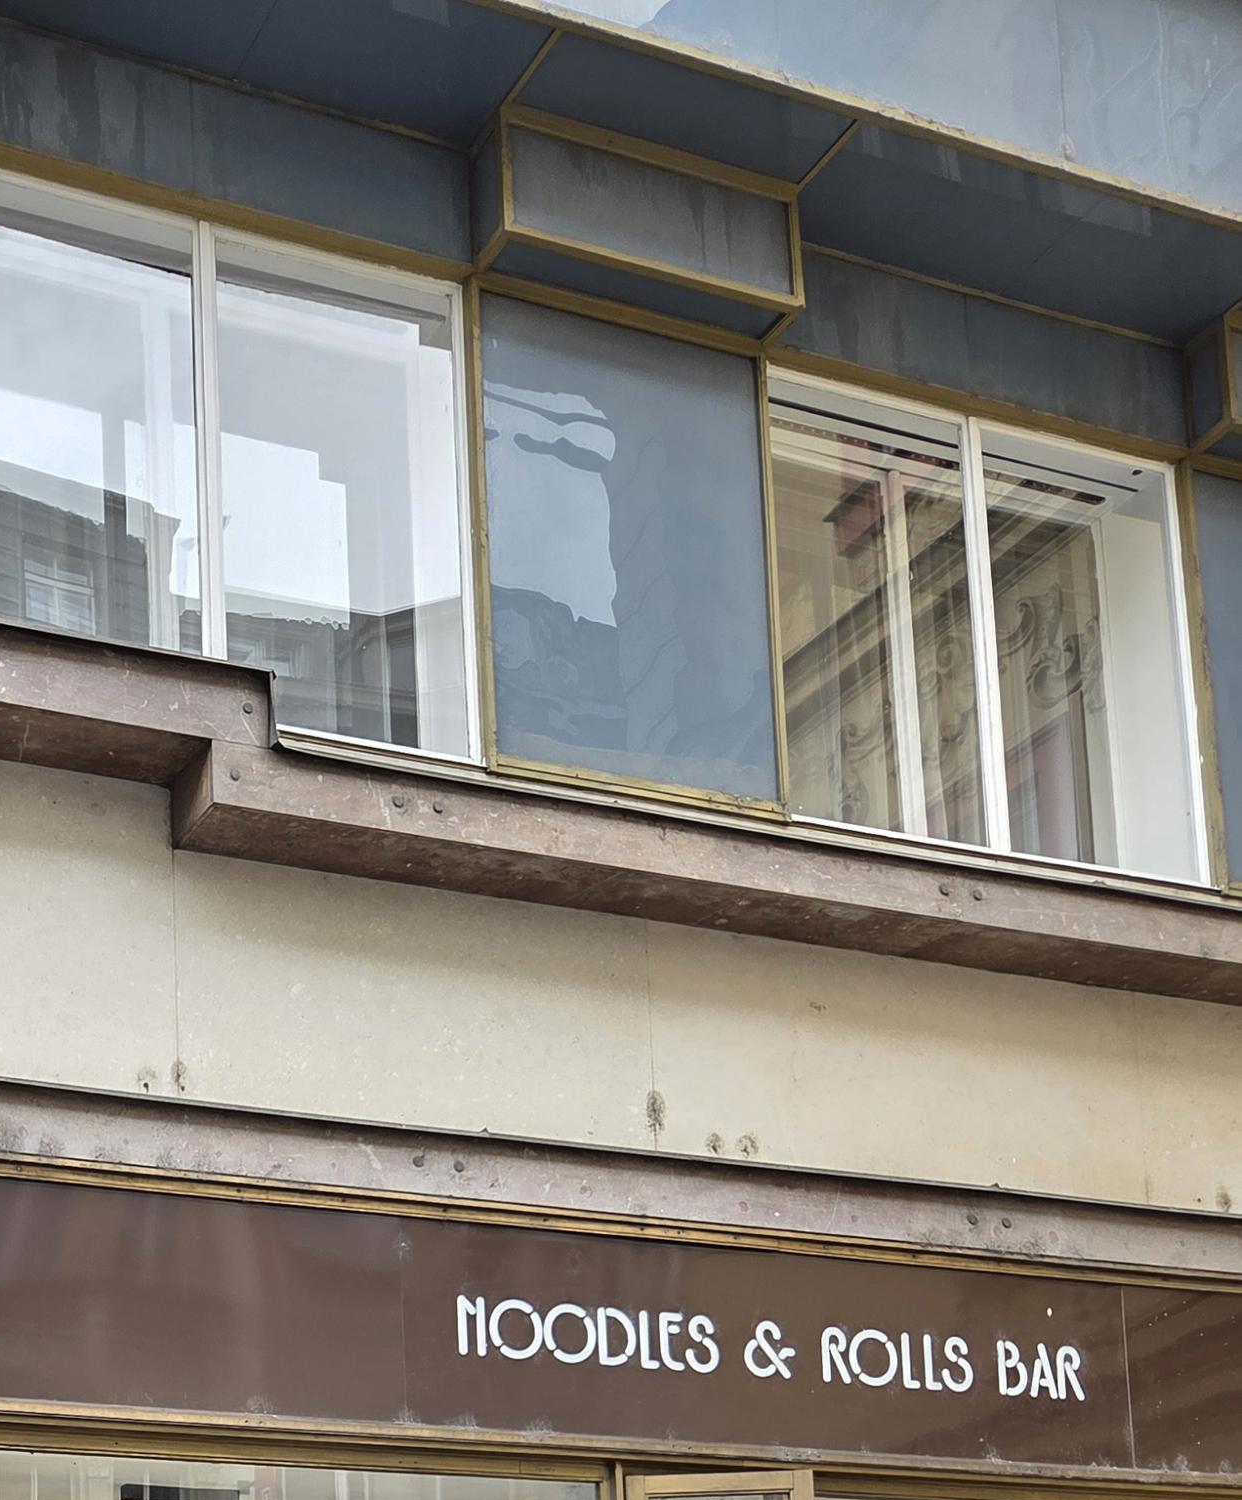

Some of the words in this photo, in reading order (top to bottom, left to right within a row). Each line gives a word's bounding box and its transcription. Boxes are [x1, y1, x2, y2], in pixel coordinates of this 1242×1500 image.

[456, 1294, 721, 1375] NOODLES
[743, 1320, 796, 1380] &
[821, 1325, 975, 1393] ROLLS
[996, 1338, 1087, 1402] BAR
